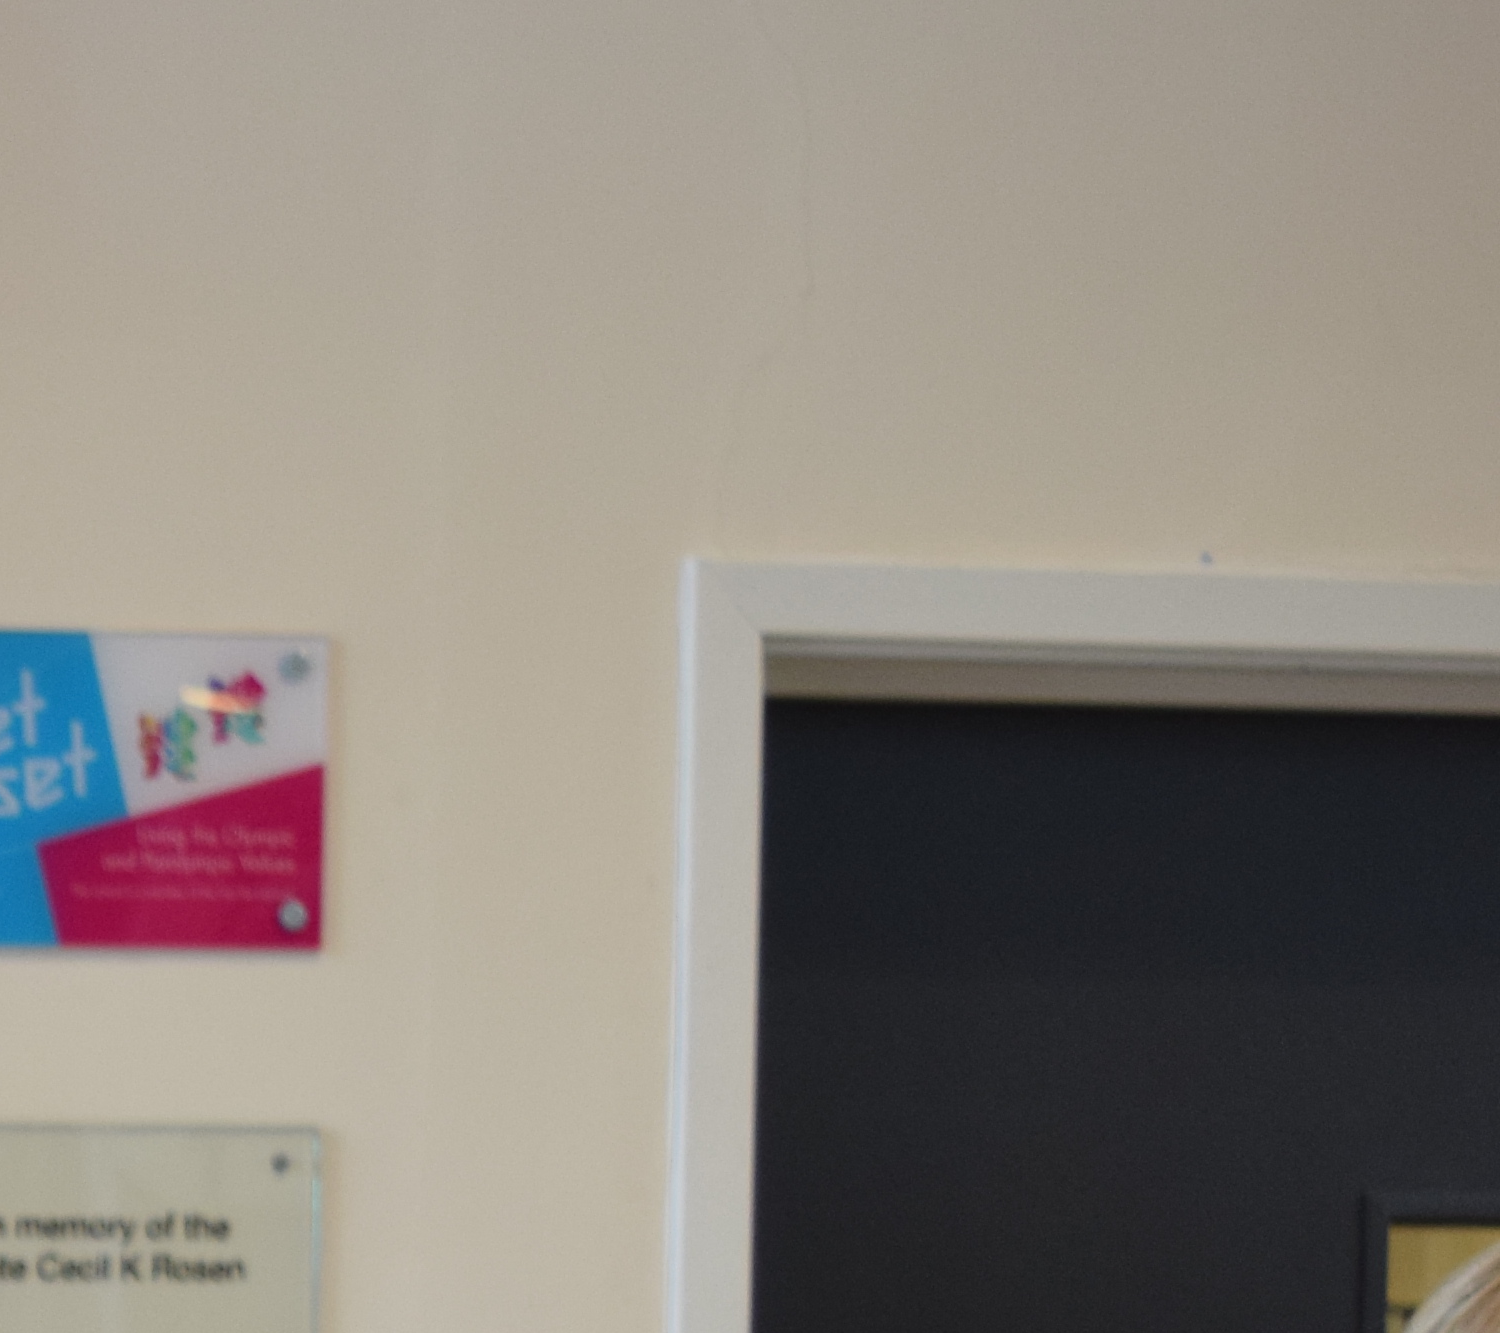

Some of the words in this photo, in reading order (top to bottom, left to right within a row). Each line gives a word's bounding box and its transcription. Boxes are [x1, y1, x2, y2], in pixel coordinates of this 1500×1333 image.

[14, 1213, 135, 1248] memory
[144, 1207, 176, 1242] of
[182, 1210, 231, 1242] the
[35, 1249, 113, 1283] Cecil
[119, 1250, 143, 1282] K
[150, 1250, 248, 1284] Rosen
